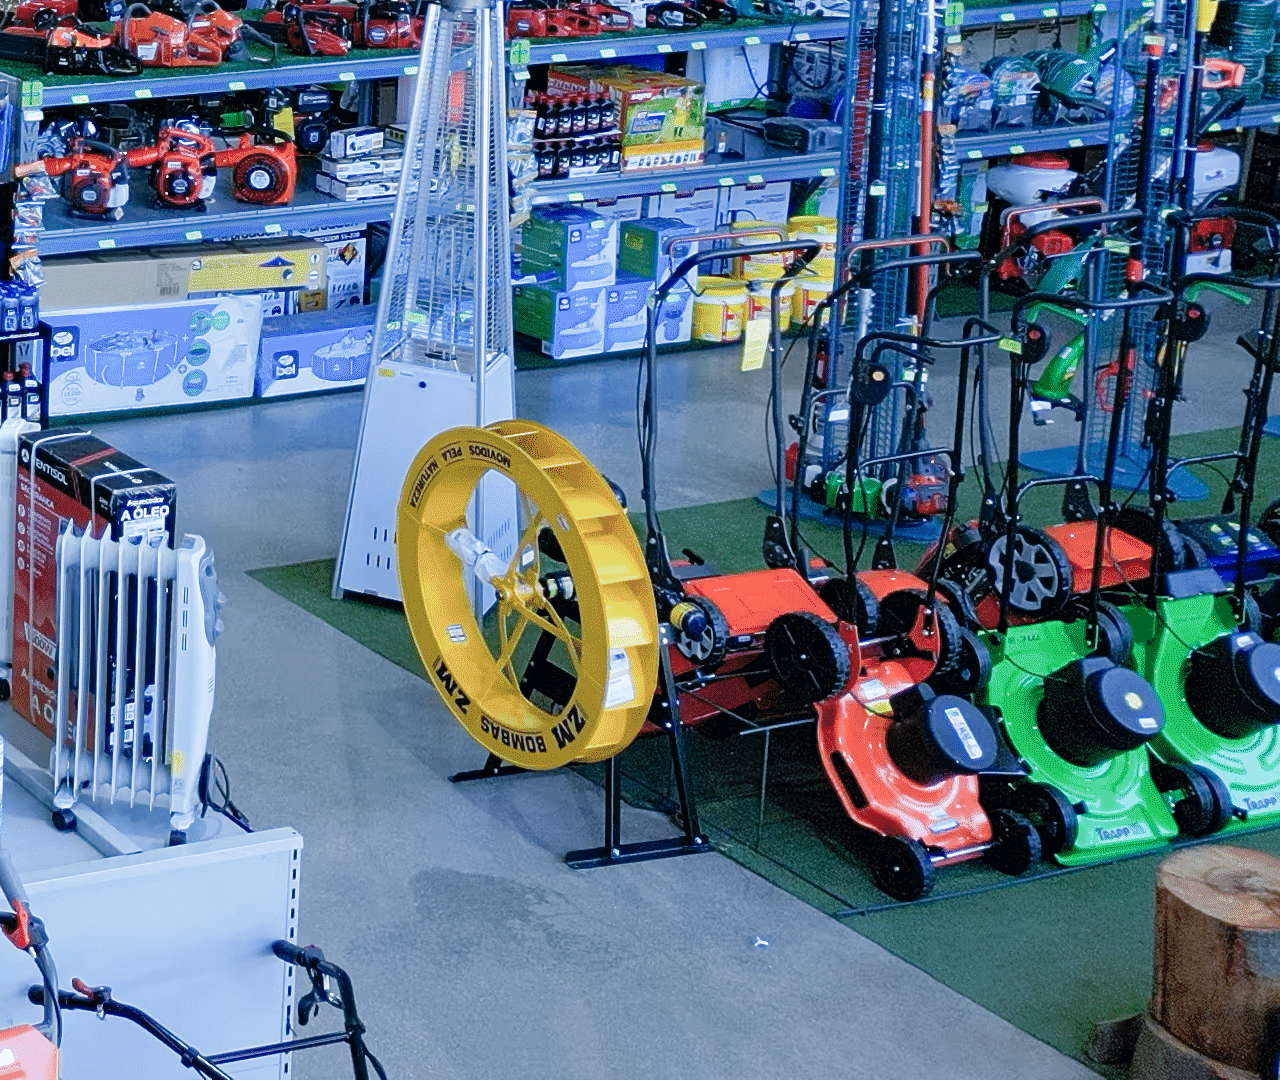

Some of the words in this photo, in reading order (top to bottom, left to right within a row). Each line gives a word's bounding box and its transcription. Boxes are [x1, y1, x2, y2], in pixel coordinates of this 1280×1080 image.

[50, 344, 69, 357] bel
[276, 364, 296, 378] bel
[441, 446, 463, 461] PELA
[468, 445, 512, 469] MOVIDOS
[35, 458, 68, 486] ENTISOL
[409, 460, 439, 508] NATUREZA
[127, 497, 165, 507] Aquecedor
[120, 510, 132, 521] A
[133, 505, 170, 520] ÓLEO
[435, 659, 471, 714] ZM
[479, 716, 547, 753] BOMBAS
[552, 704, 587, 751] ZM
[1095, 827, 1130, 840] TRAPP
